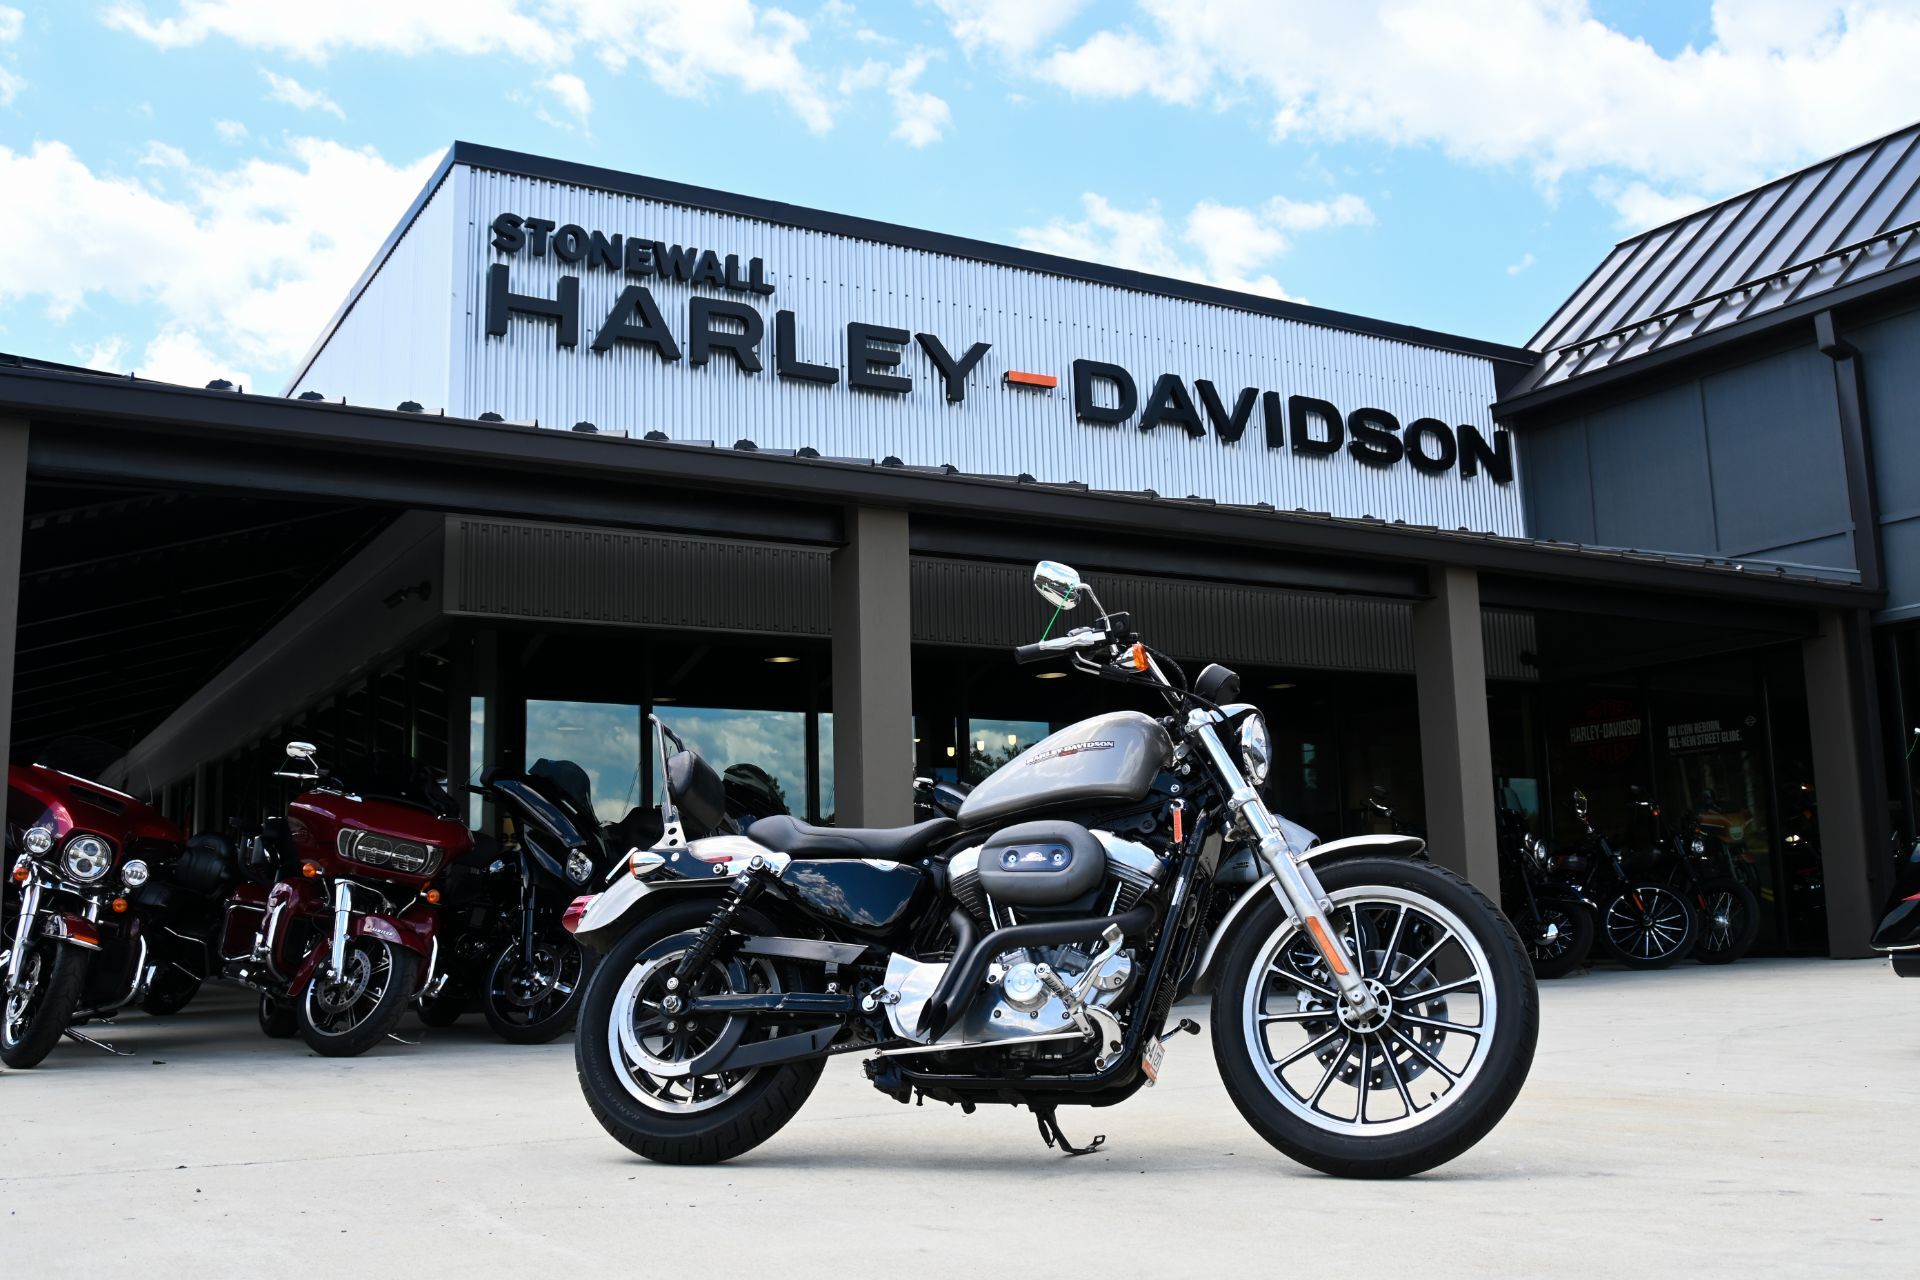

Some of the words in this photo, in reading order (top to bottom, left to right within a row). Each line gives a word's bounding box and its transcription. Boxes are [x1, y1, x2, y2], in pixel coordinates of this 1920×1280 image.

[491, 211, 776, 296] STONEWALL
[1667, 725, 1677, 737] AN
[1678, 723, 1694, 736] ICON
[1669, 735, 1697, 749] ALL-NEW
[1697, 731, 1721, 746] STREET
